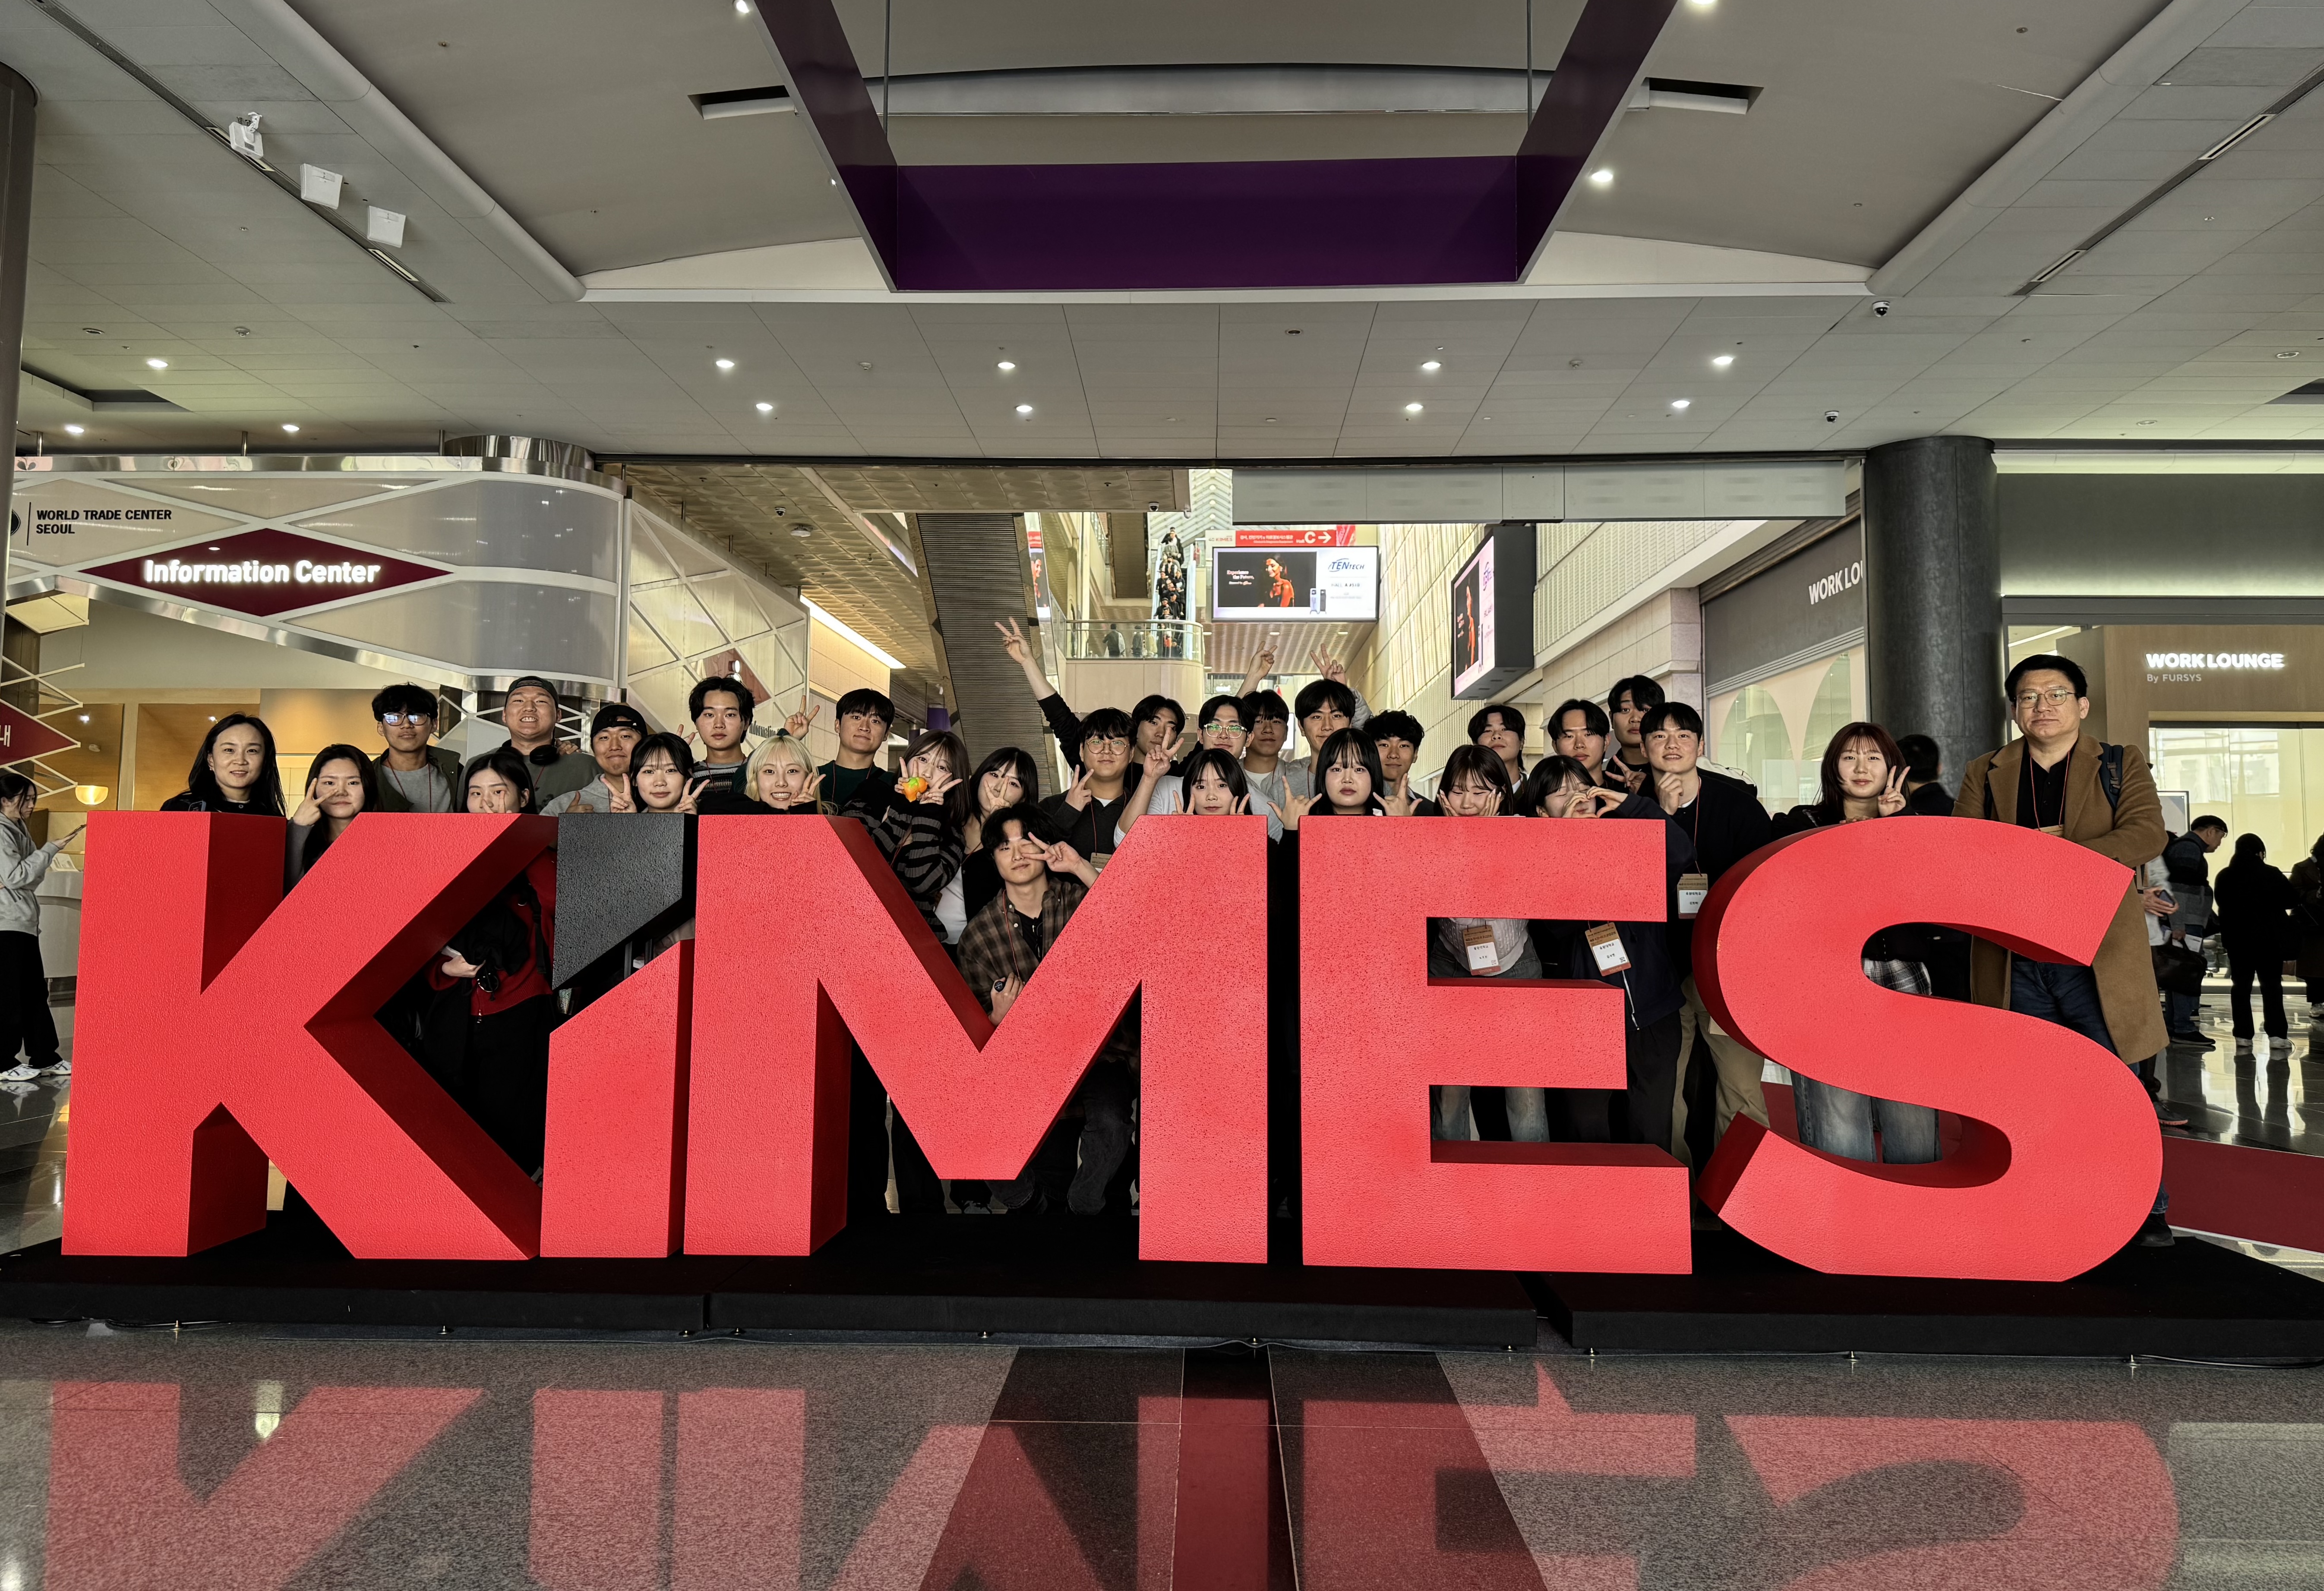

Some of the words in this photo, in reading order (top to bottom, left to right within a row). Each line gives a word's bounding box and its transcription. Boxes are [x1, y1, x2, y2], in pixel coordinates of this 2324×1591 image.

[37, 510, 79, 520] WORLD
[83, 510, 122, 520] TRADE
[125, 510, 172, 520] CENTER
[36, 524, 75, 534] SEOUL
[1304, 531, 1316, 544] C
[144, 559, 290, 583] Information
[294, 560, 381, 583] Center
[1809, 570, 1844, 605] WORK
[2146, 653, 2205, 668] WORK
[2207, 653, 2285, 668] LOUNGE
[2147, 674, 2158, 683] By
[2163, 674, 2202, 682] FURSYS
